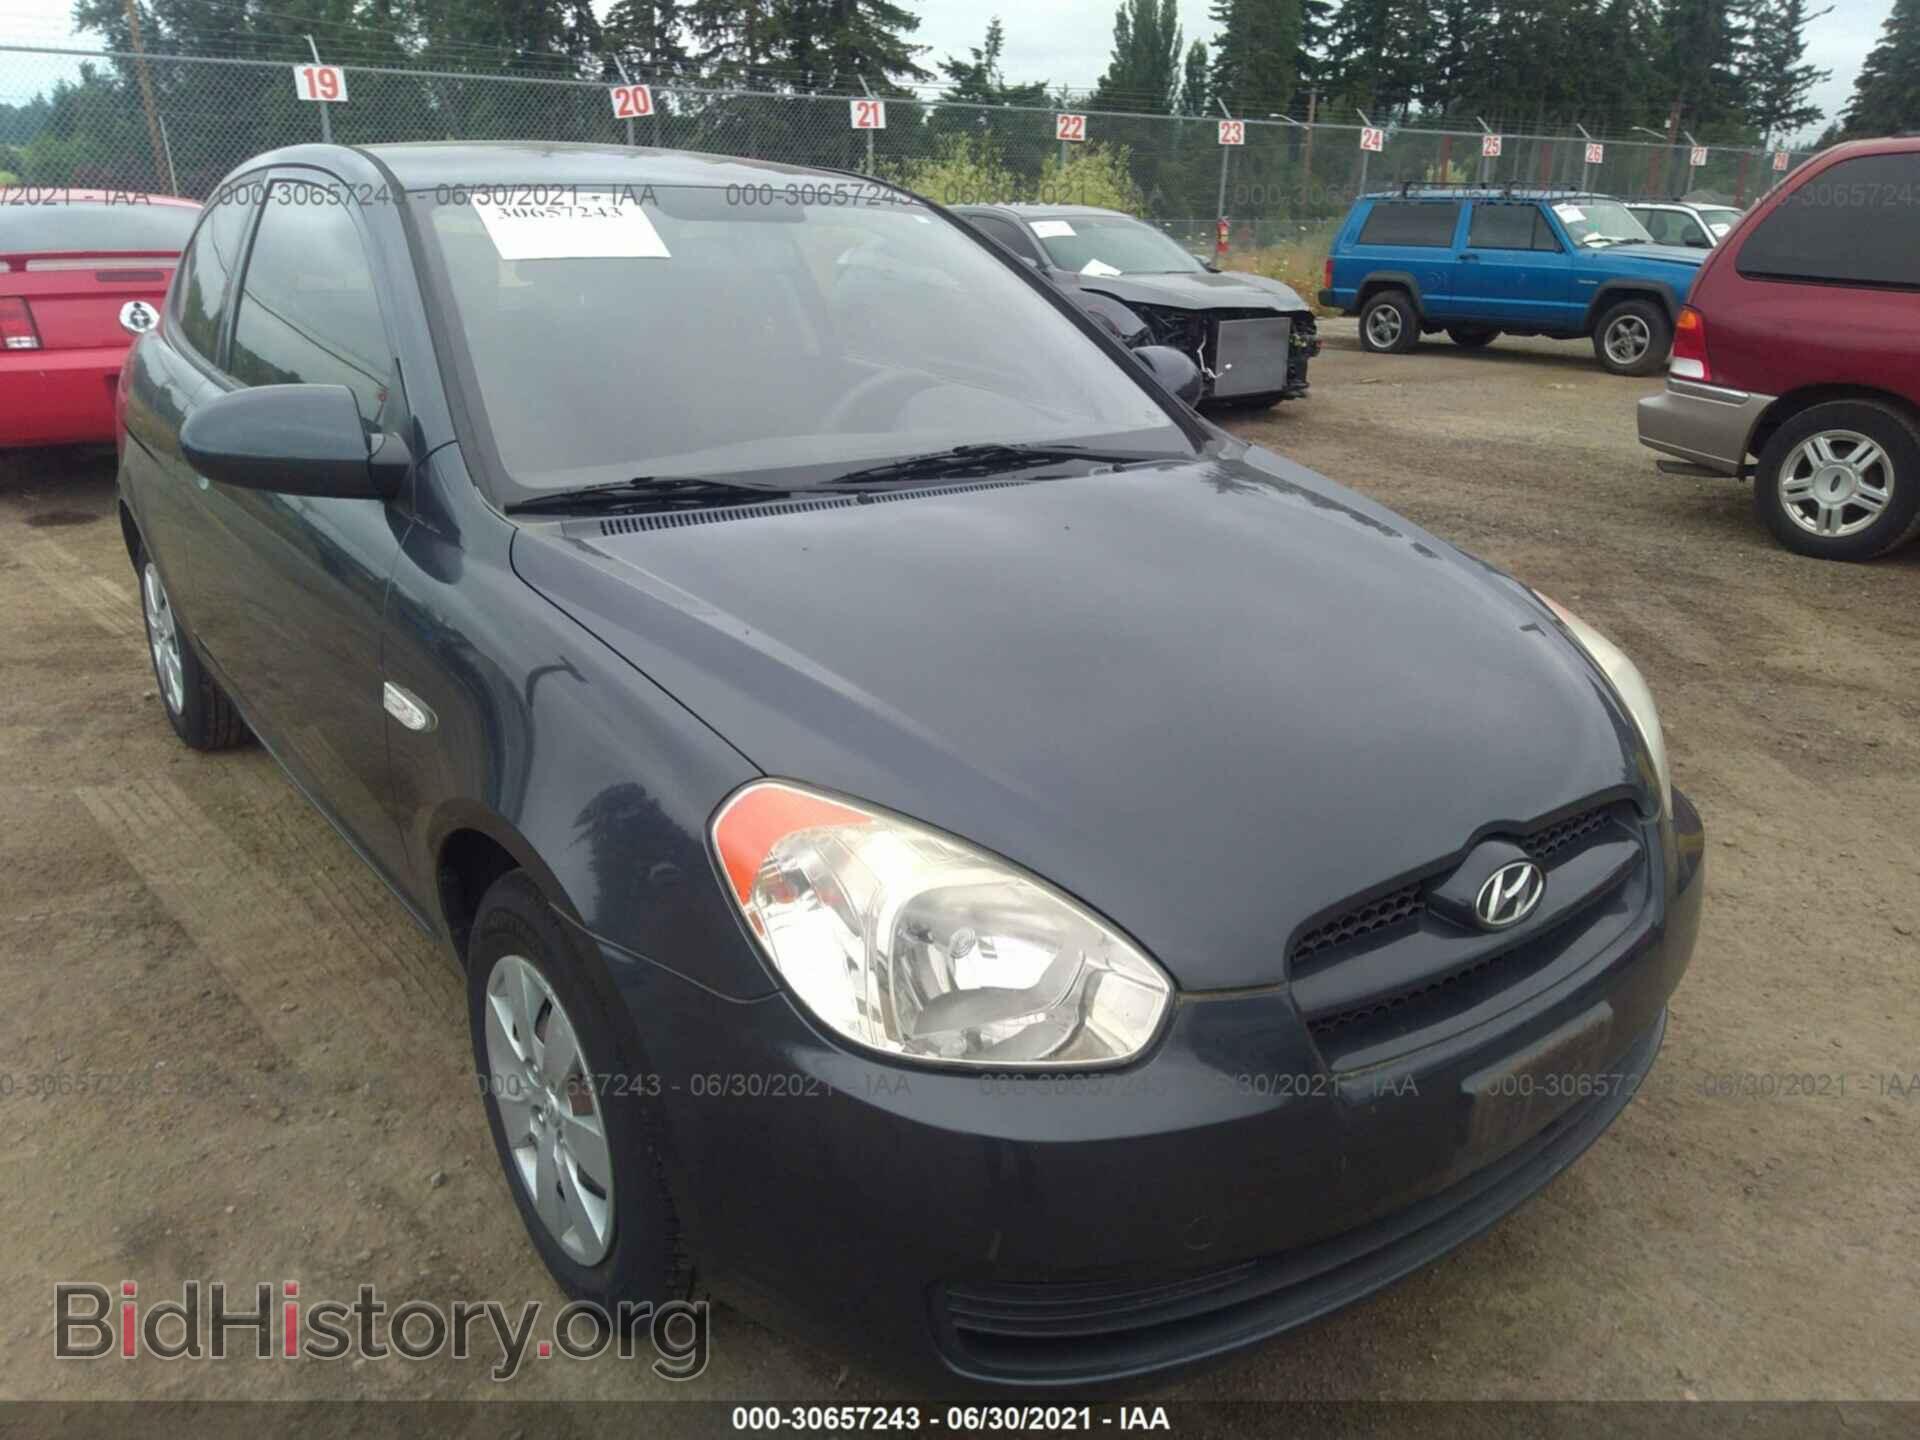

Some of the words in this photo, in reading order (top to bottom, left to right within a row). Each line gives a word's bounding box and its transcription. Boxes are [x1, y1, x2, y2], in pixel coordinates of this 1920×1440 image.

[303, 68, 338, 98] 19
[615, 86, 649, 116] 20
[857, 102, 879, 127] 21
[1060, 115, 1082, 138] 22
[1221, 122, 1242, 143] 23
[1363, 129, 1381, 149] 24
[498, 207, 624, 219] 30657243
